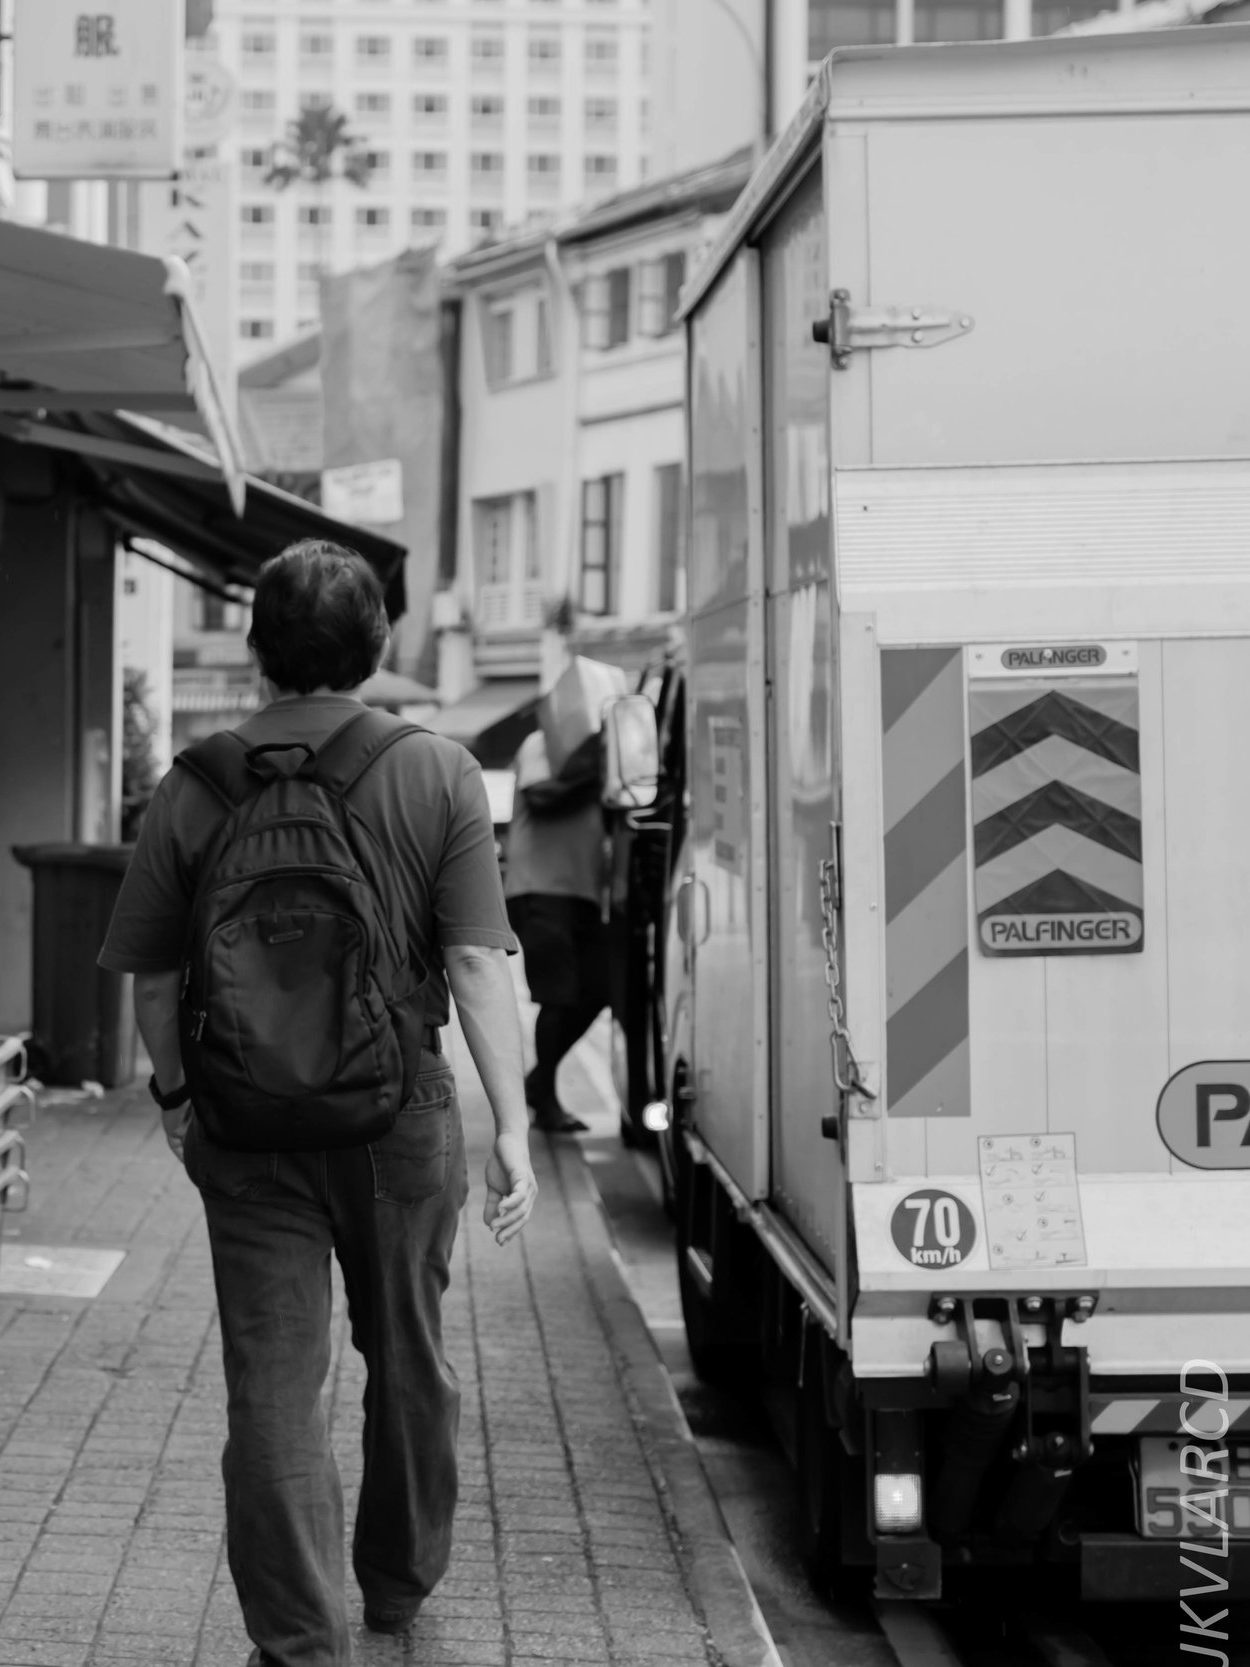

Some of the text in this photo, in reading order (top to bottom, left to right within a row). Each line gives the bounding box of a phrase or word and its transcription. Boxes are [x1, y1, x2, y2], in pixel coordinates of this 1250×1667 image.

[990, 918, 1131, 943] PALFINGER
[1196, 1083, 1250, 1147] P
[904, 1197, 961, 1248] 70
[910, 1245, 962, 1266] km/h
